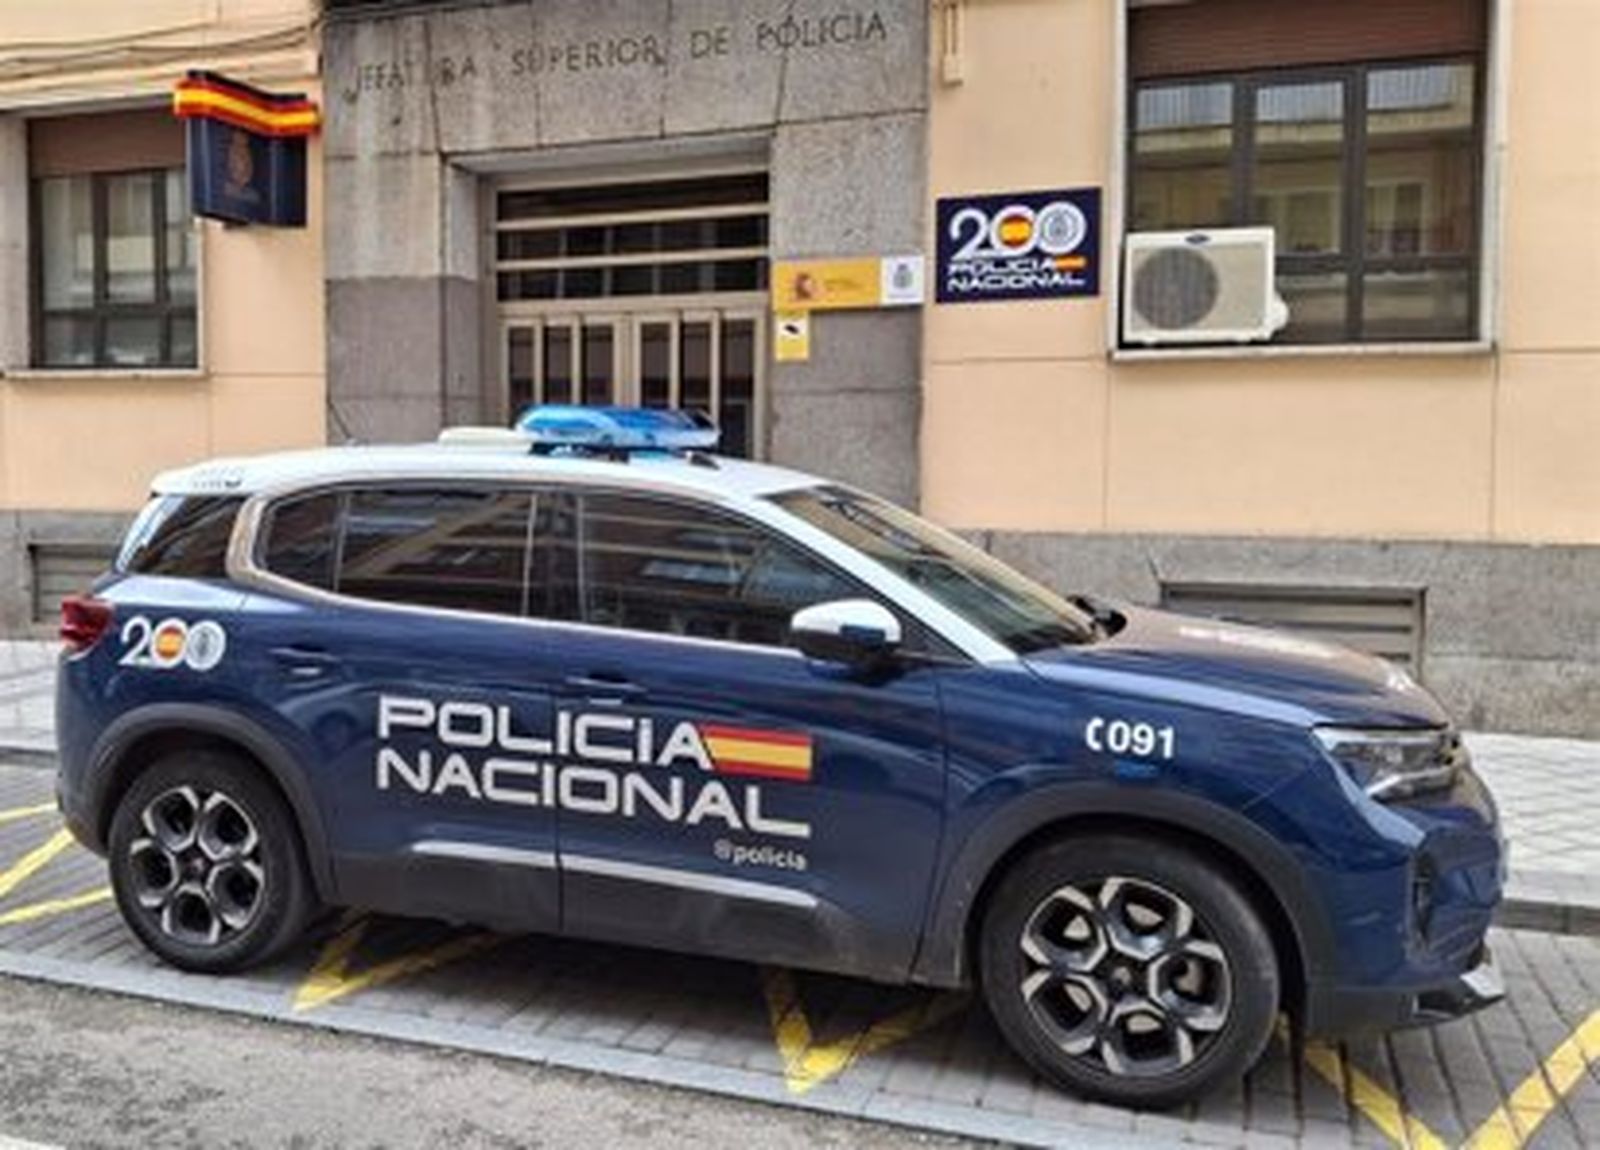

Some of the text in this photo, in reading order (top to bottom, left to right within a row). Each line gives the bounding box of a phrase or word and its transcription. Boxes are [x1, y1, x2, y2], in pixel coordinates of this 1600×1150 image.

[511, 35, 667, 76] SUPERIOR
[690, 26, 729, 59] DE
[950, 201, 1087, 261] 200
[118, 615, 226, 671] 200
[377, 747, 811, 838] NACIONAL
